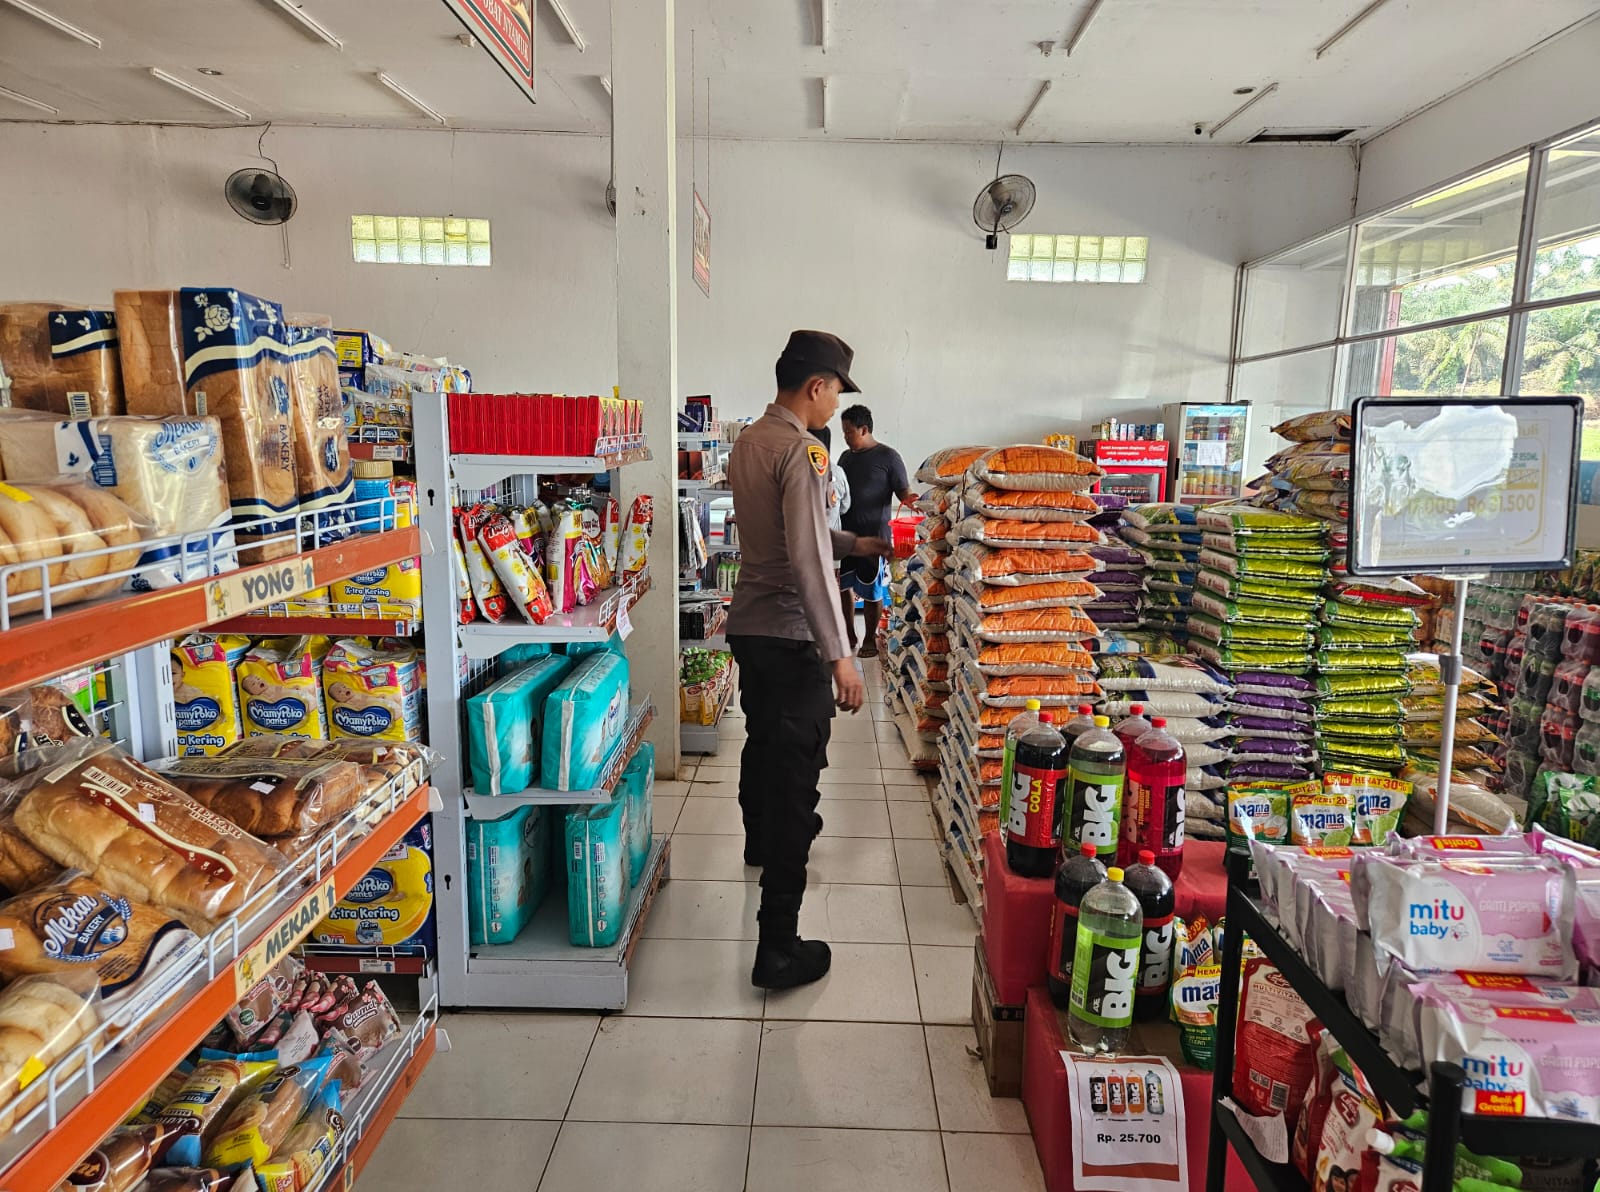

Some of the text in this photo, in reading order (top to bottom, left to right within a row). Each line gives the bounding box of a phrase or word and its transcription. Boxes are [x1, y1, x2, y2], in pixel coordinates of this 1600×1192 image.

[280, 423, 290, 473] BAKERY
[242, 567, 295, 603] YONG
[364, 587, 390, 596] Kering
[252, 705, 302, 720] MamyPoko
[265, 718, 289, 726] pants
[336, 712, 389, 727] MamyPoko
[187, 735, 224, 747] Kering
[1384, 778, 1407, 792] 30%
[1029, 779, 1042, 814] COLA
[1357, 794, 1391, 816] ama
[184, 800, 243, 839] MEKAR
[1080, 784, 1117, 847] BIG
[1300, 812, 1344, 829] mama
[359, 907, 399, 921] Kering
[1409, 898, 1465, 921] mitu
[43, 894, 99, 954] Mekar
[78, 913, 105, 944] BAKERY
[264, 897, 320, 964] MEKAR
[1409, 921, 1449, 940] baby
[1101, 948, 1141, 1019] BIG
[1462, 1055, 1524, 1077] mitu
[1478, 1103, 1514, 1113] Gratis
[1490, 1094, 1513, 1102] Beli
[1097, 1134, 1161, 1144] Rp. 25.700
